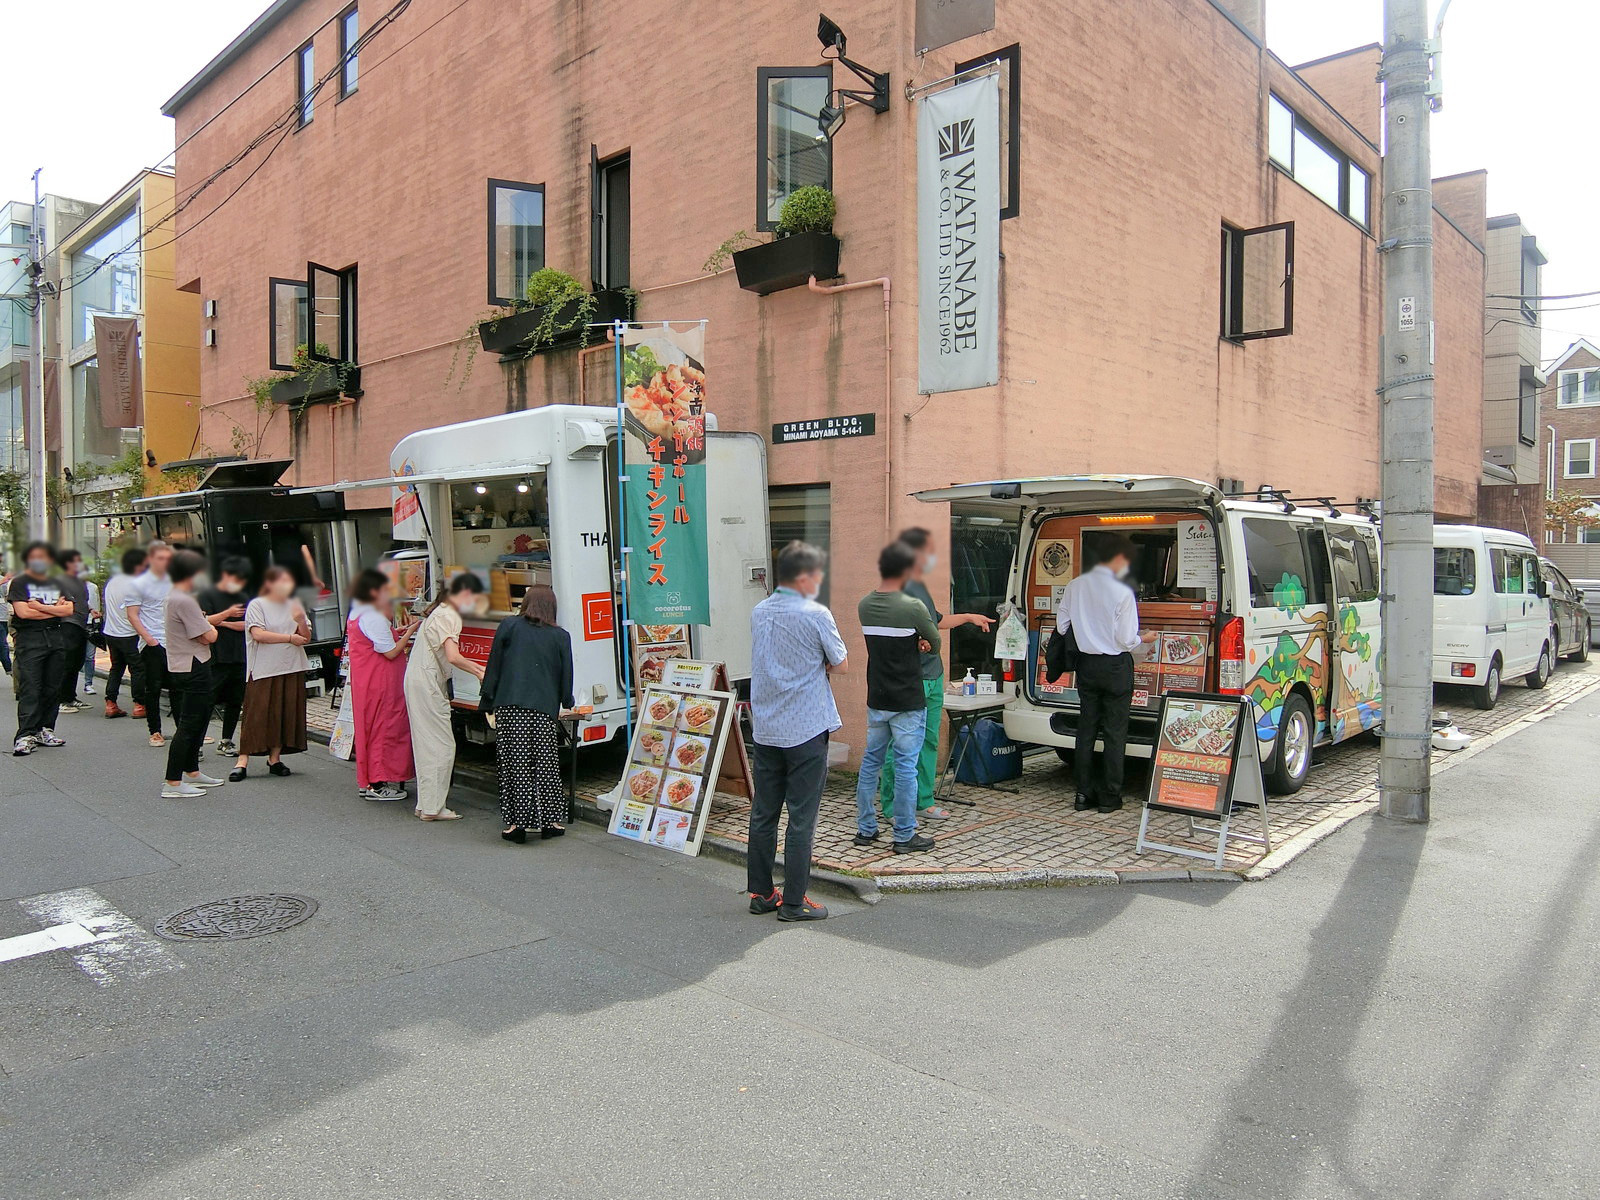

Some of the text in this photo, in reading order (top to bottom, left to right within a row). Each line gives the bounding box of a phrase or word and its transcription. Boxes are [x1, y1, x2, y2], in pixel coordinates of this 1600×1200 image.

[940, 168, 950, 183] &
[939, 186, 952, 219] CO.,
[939, 222, 952, 259] LTD.
[953, 158, 978, 353] WATANABE
[116, 343, 132, 415] BRITISH MADE
[783, 417, 862, 433] GREEN BLDG.
[783, 425, 862, 441] MINAMI AOYAMA 5-14-1
[669, 379, 690, 524] シンガポール
[647, 435, 668, 586] チキンライス
[594, 610, 612, 622] ゴー
[1160, 752, 1228, 772] チキンオーバーライス
